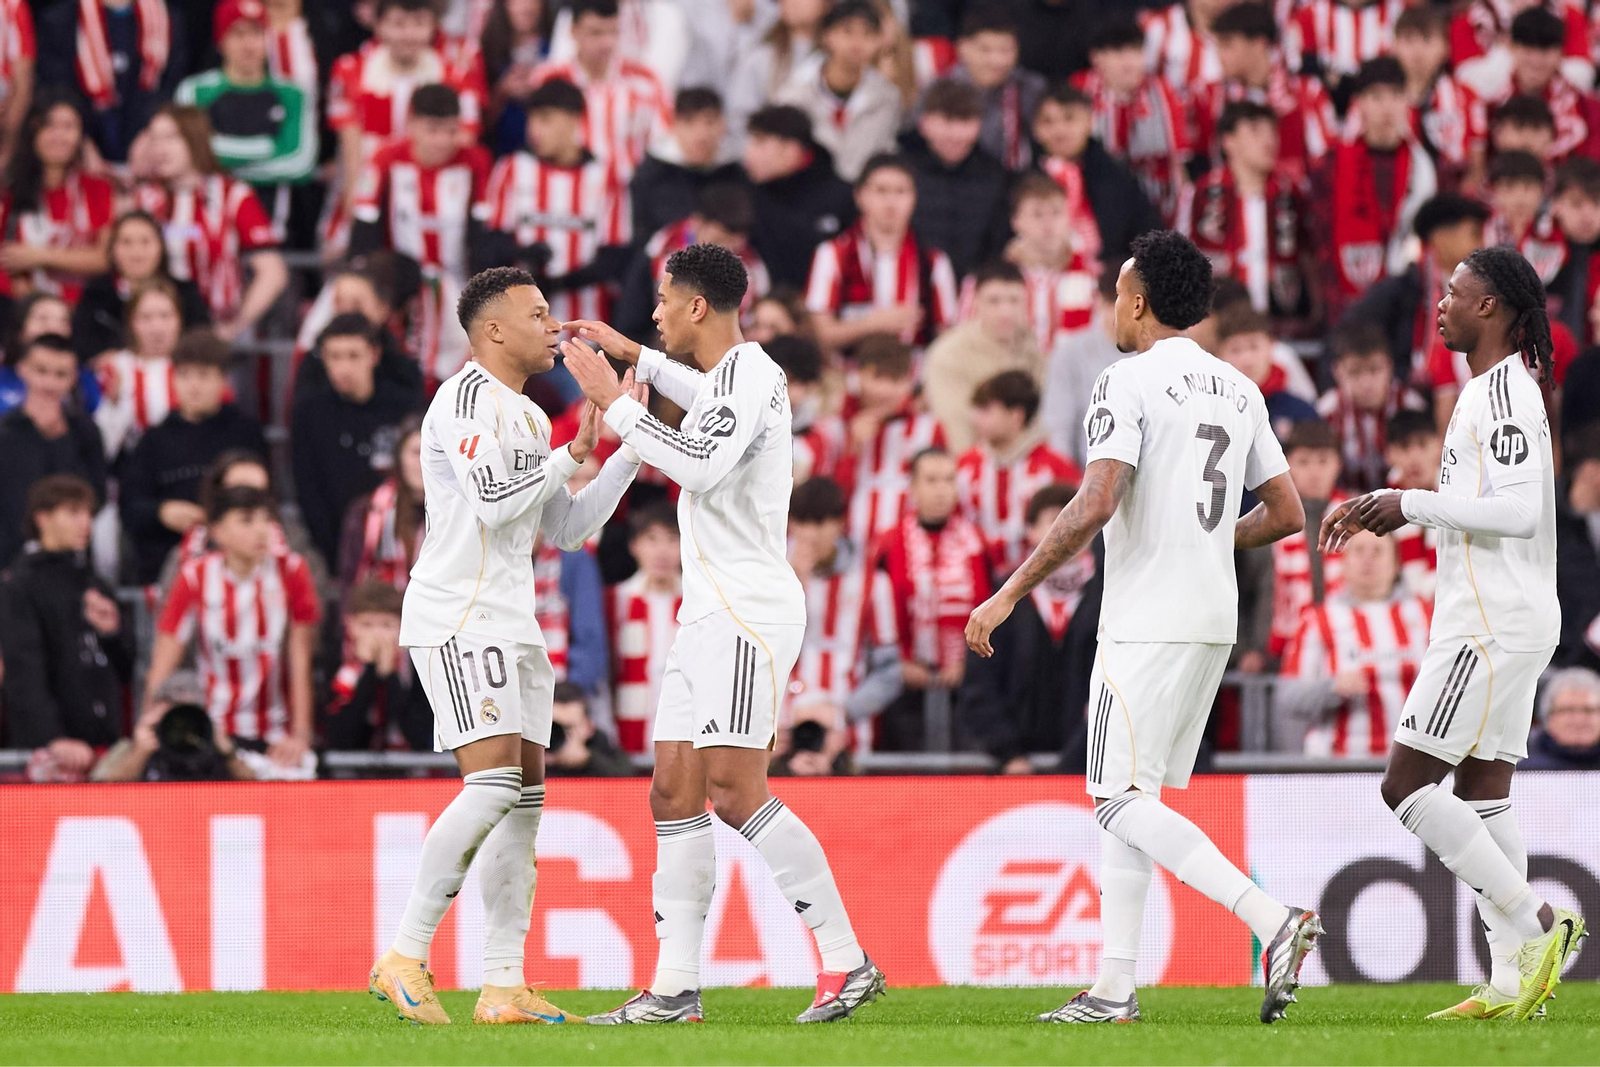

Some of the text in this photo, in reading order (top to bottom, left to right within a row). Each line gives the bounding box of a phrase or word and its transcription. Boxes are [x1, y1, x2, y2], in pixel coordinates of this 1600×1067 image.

[1165, 372, 1248, 414] E. MILITÃO
[699, 406, 737, 437] hp
[1089, 408, 1115, 446] hp
[513, 448, 549, 471] Emir
[1491, 425, 1528, 466] hp
[1195, 423, 1231, 534] 3
[462, 646, 507, 692] 10
[979, 862, 1101, 935] EA
[973, 944, 1102, 978] SPORT
